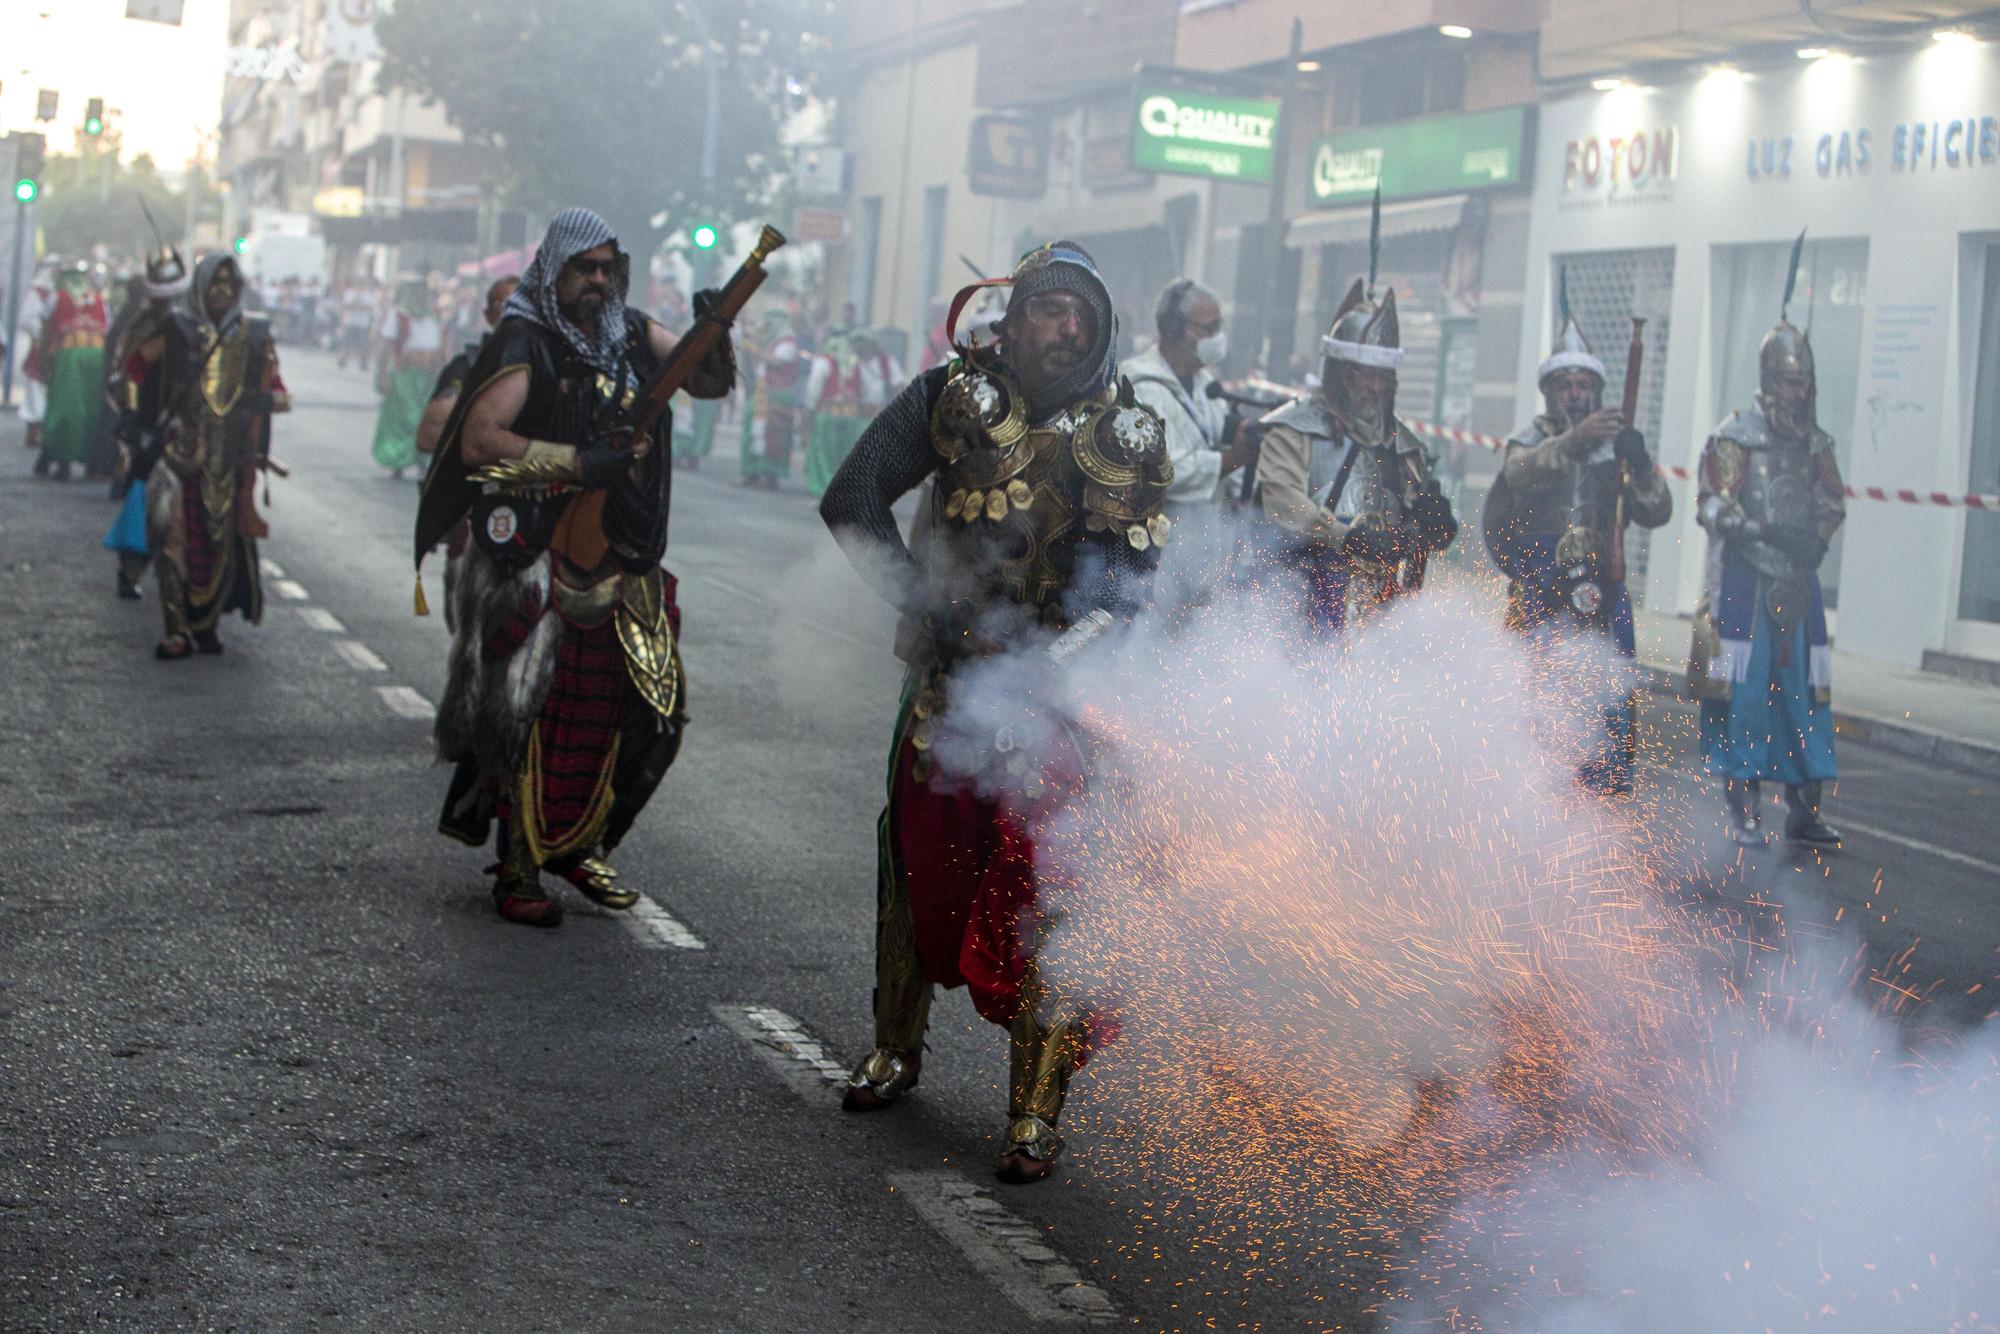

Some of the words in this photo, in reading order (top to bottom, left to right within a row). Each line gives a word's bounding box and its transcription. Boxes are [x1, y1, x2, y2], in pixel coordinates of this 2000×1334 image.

[1564, 126, 1679, 190] FOTON
[1746, 136, 1794, 179] LUZ
[1816, 128, 1872, 179] GAS
[1893, 116, 2000, 172] EFICIE
